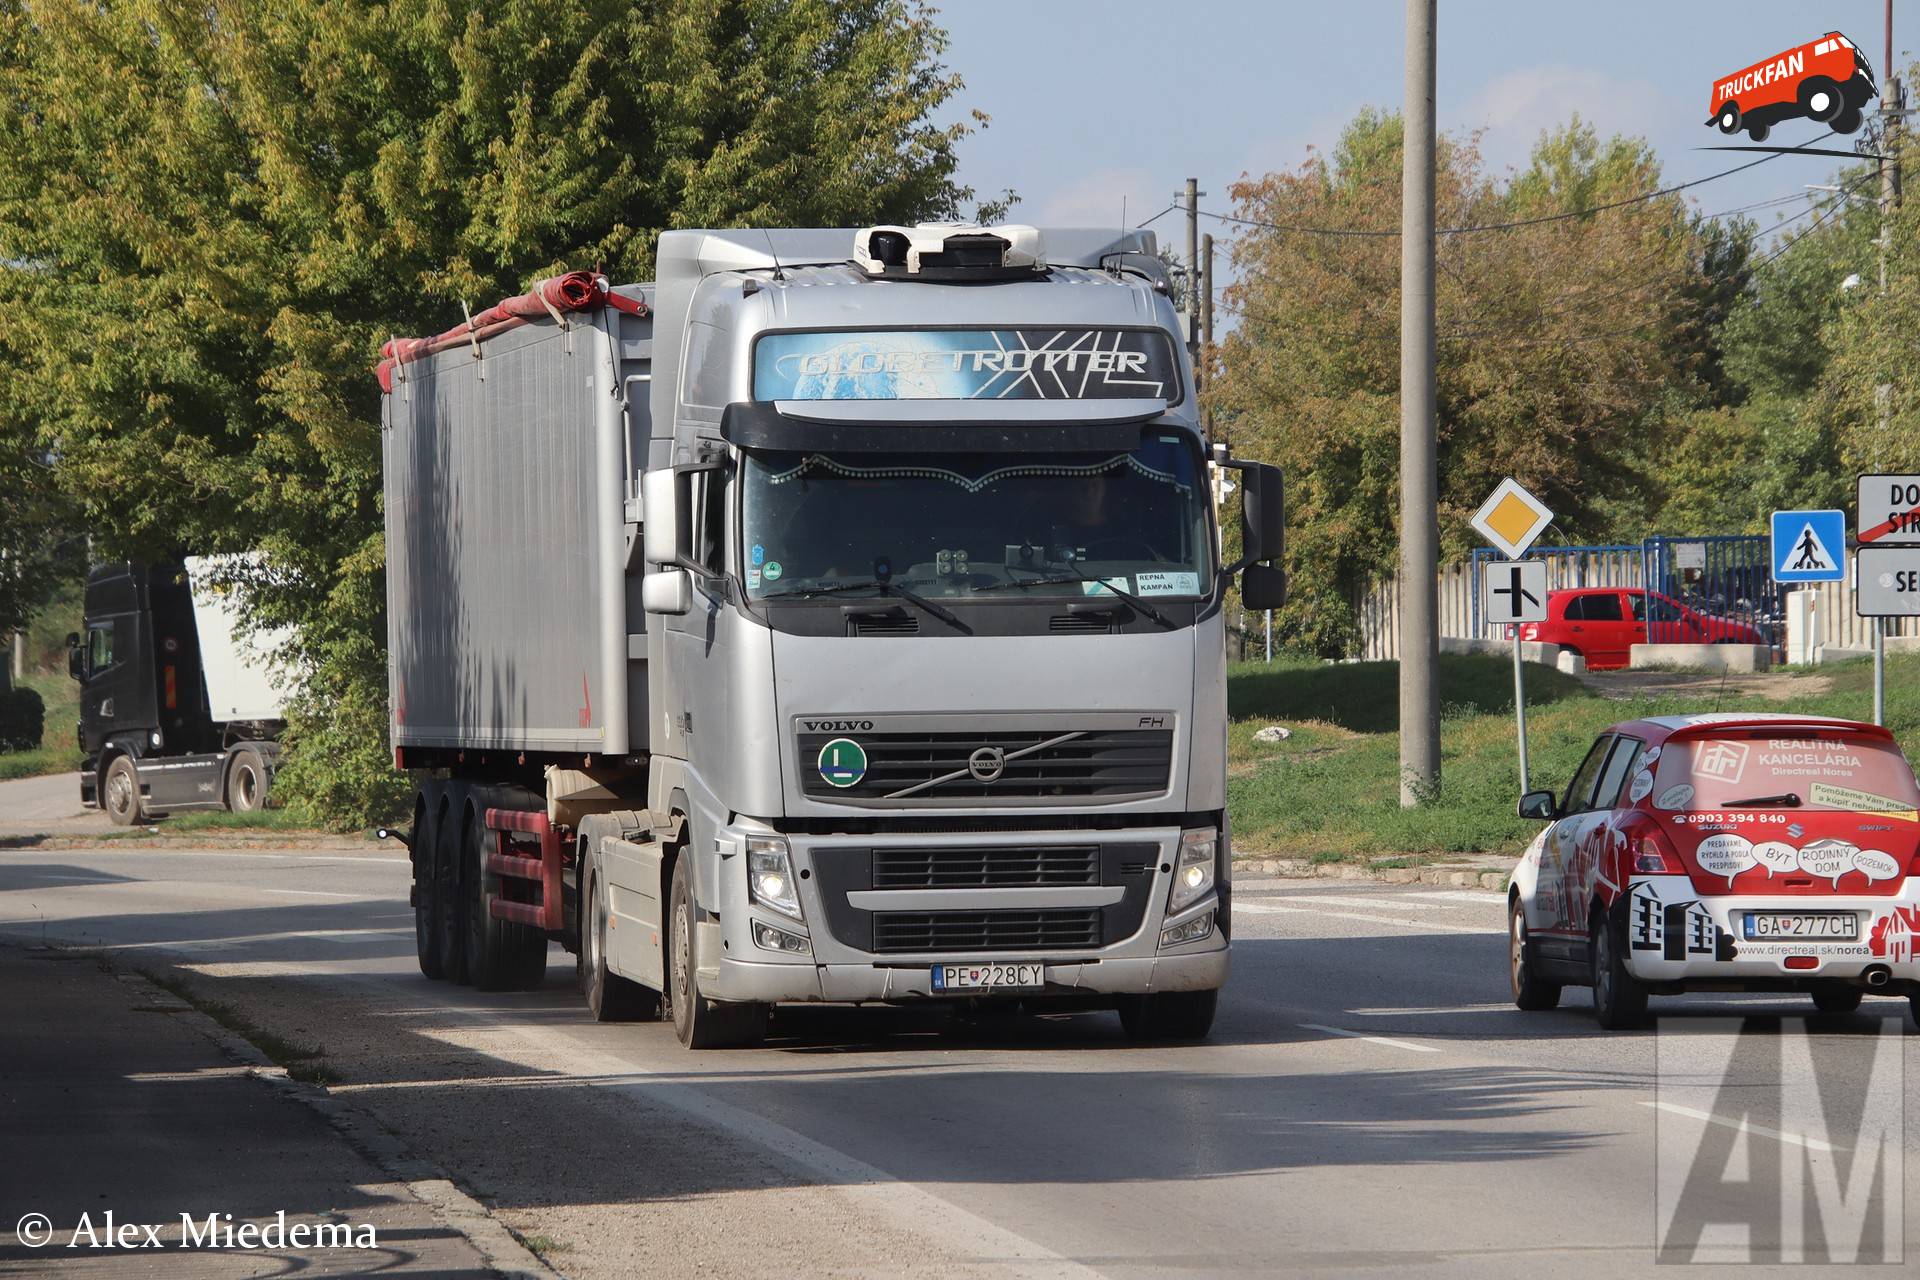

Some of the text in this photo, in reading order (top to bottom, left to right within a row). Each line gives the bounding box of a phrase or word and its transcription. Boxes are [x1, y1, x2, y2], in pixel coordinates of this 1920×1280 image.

[799, 350, 1149, 375] GLOBETROTTER
[1891, 484, 1920, 505] DO
[803, 720, 874, 731] VOLVO
[1139, 717, 1164, 728] FH
[1759, 753, 1862, 767] KANCELÁRIA
[1688, 814, 1786, 823] 0903 394 840
[1765, 848, 1792, 865] BYT
[1815, 861, 1841, 873] DOM
[1757, 916, 1855, 935] GA 277CH
[1739, 944, 1870, 955] www.directreal.sk/norea
[945, 965, 1041, 986] PE 228CY
